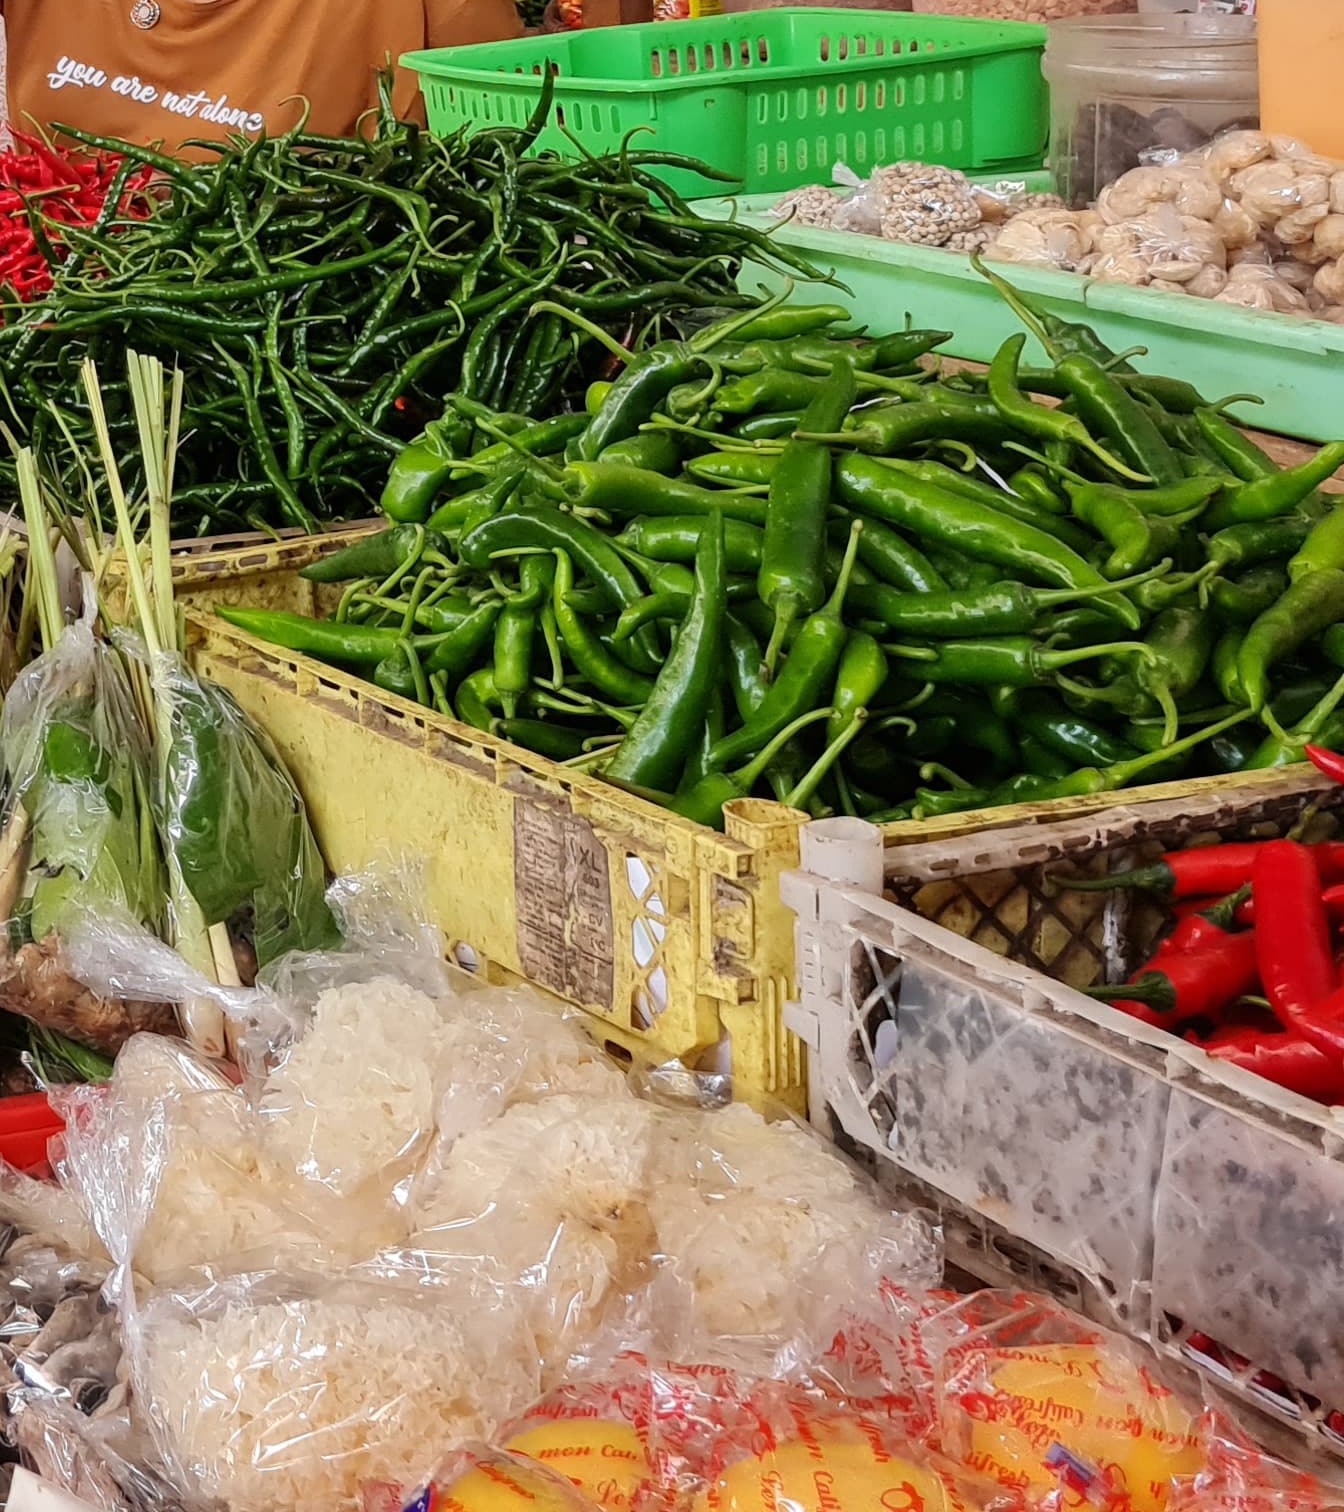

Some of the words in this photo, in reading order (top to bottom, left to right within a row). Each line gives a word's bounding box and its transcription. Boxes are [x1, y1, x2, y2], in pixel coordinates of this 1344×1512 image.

[47, 55, 108, 90] you
[110, 75, 159, 104] are
[160, 89, 209, 119] not
[199, 96, 265, 132] alone
[539, 1444, 592, 1459] mon
